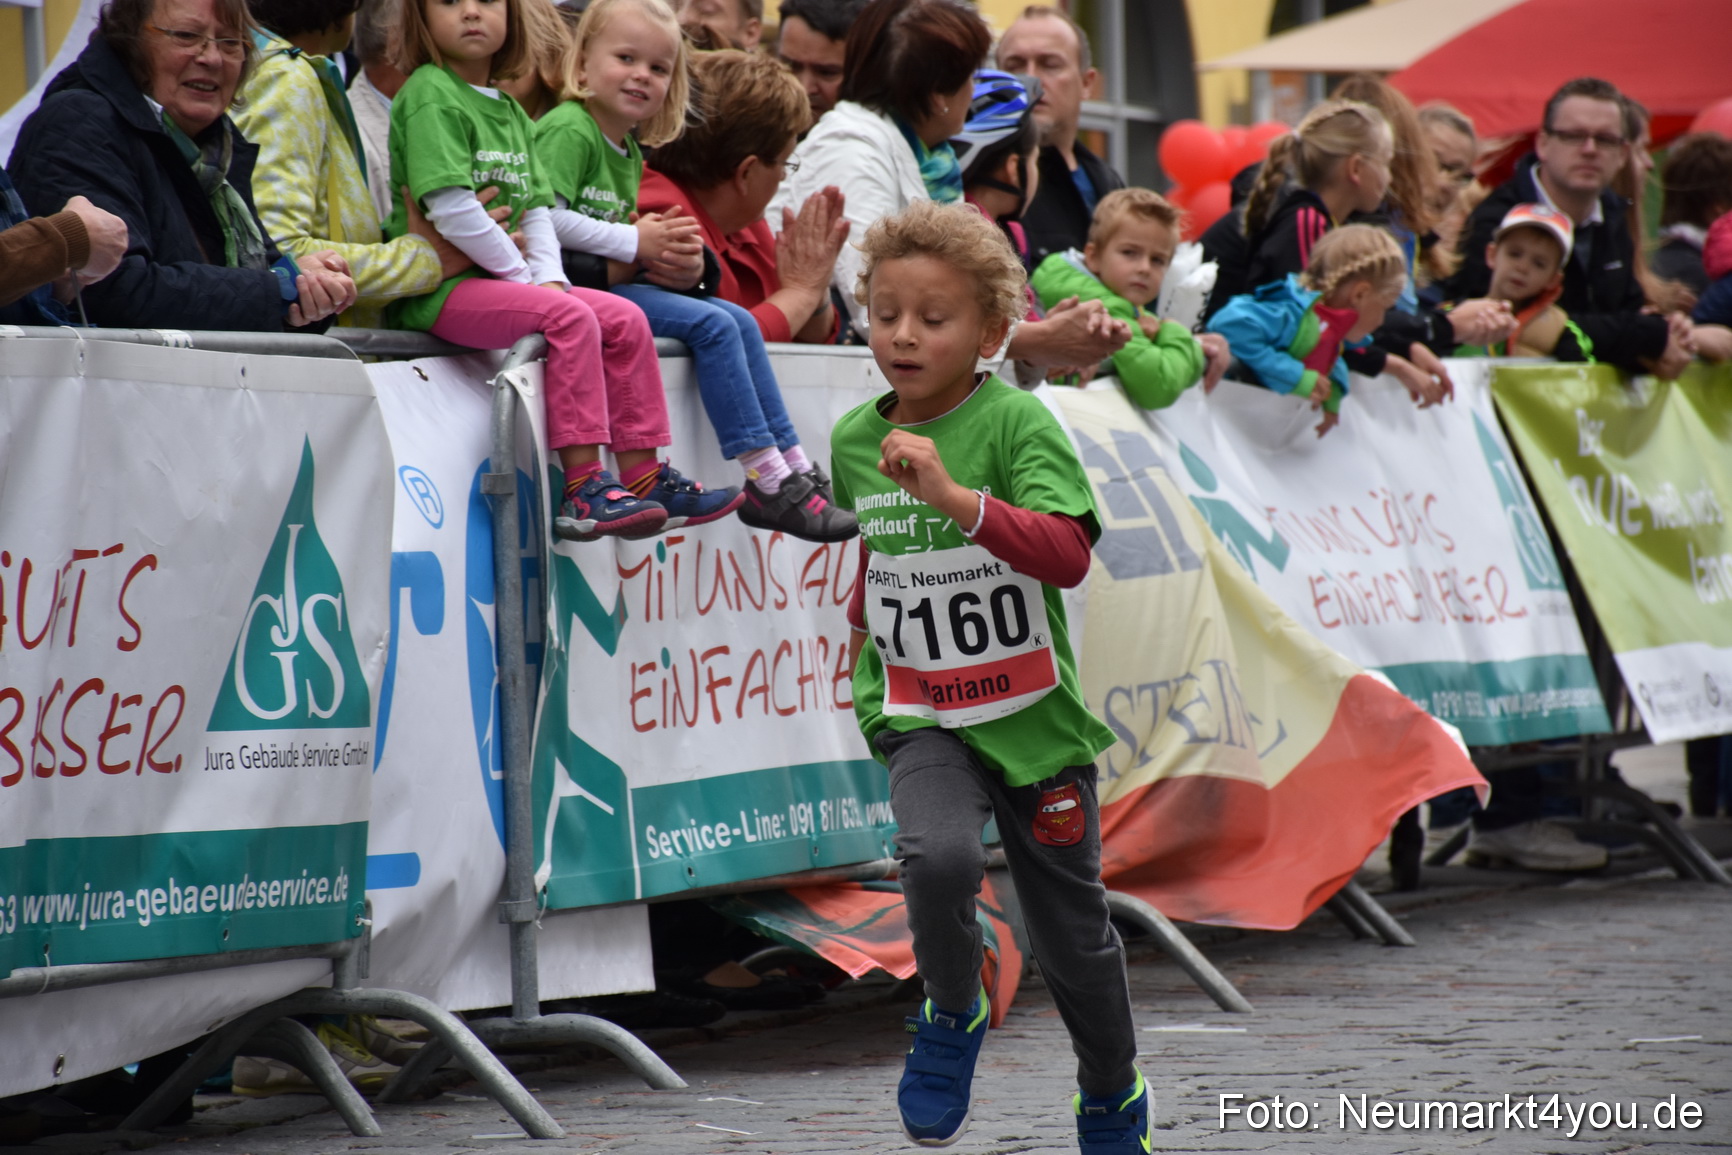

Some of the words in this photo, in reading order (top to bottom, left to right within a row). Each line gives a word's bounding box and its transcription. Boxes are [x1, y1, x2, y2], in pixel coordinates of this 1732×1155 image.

[695, 530, 788, 616] UNS
[868, 569, 908, 590] PARTL
[911, 561, 1003, 588] Neumarkt
[880, 584, 1030, 661] 7160
[204, 746, 235, 772] Jura
[239, 743, 299, 770] Gebäude
[302, 743, 339, 768] Service
[342, 740, 369, 766] GmbH
[645, 808, 786, 860] Service-Line:
